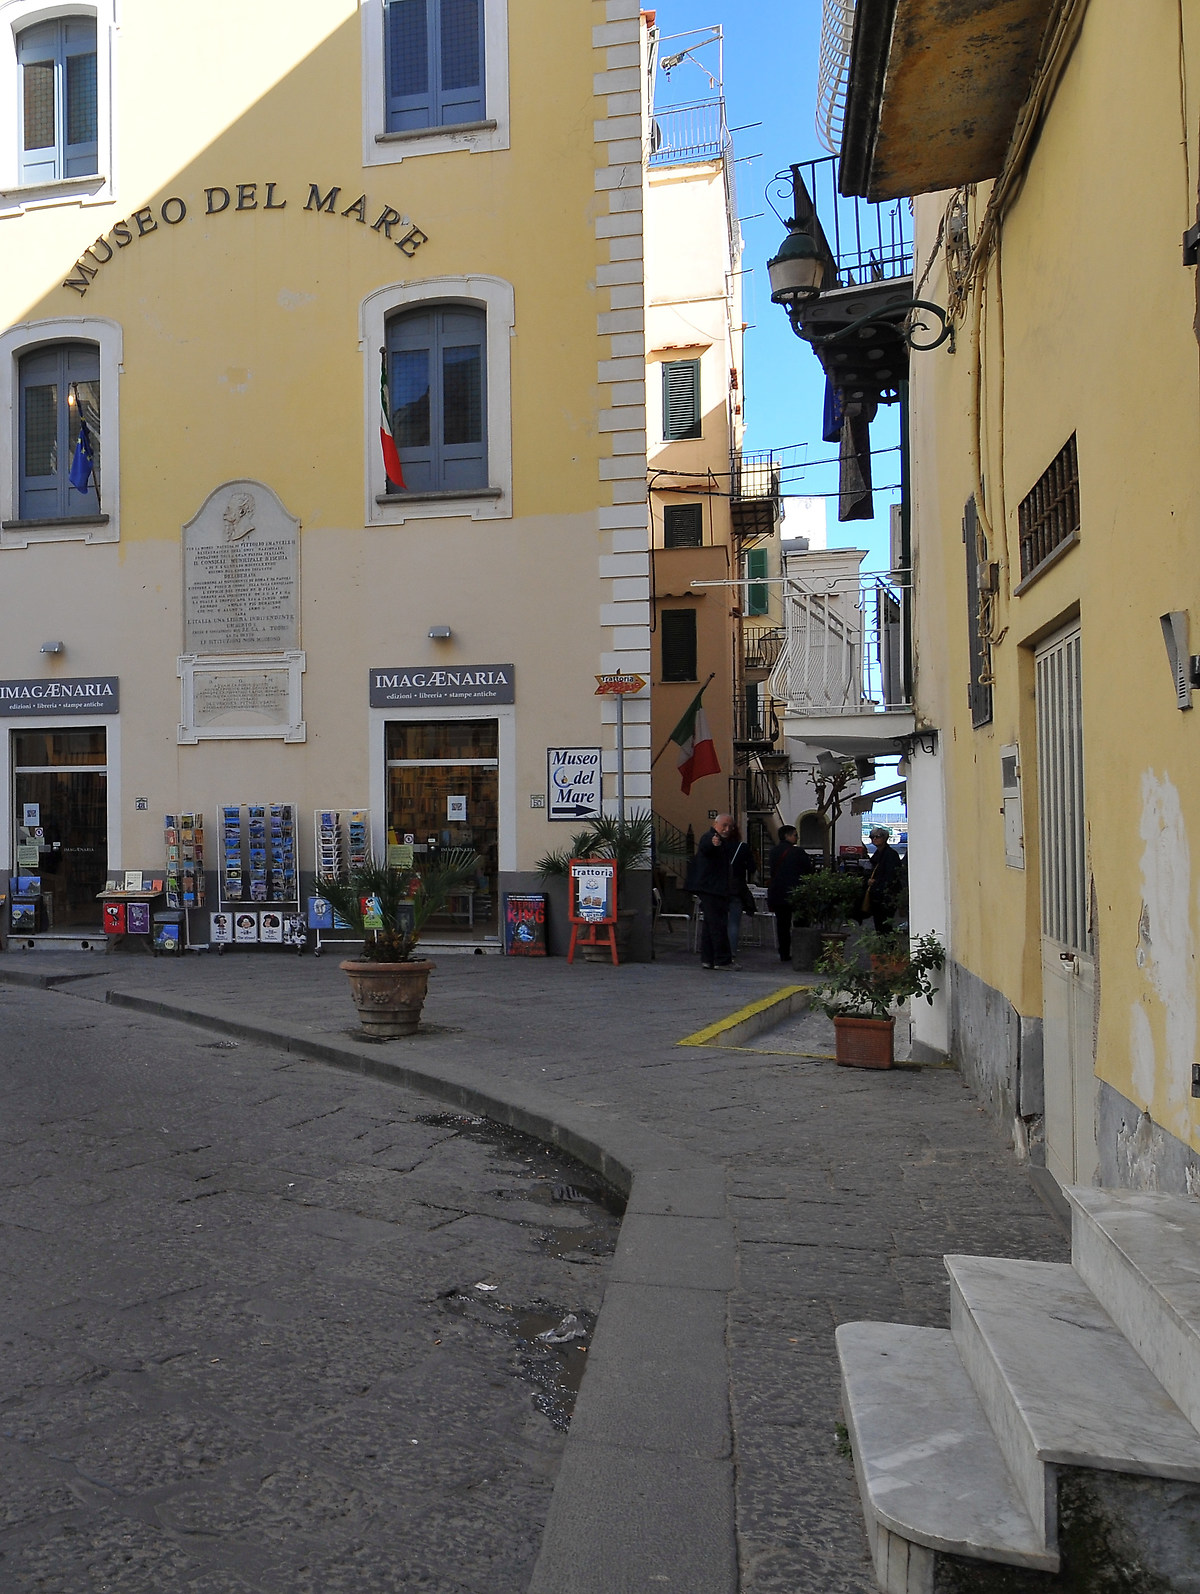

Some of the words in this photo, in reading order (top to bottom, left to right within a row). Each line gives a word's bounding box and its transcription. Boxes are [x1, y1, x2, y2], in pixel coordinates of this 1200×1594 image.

[62, 196, 187, 298] MUSEO
[203, 182, 287, 214] DEL
[302, 183, 429, 258] MARE
[376, 671, 508, 688] IMAGÆNARIA
[602, 675, 634, 683] Trattoria
[0, 683, 113, 699] IMAGÆNARIA
[386, 692, 412, 700] edizioni
[449, 692, 472, 700] stampe
[473, 690, 497, 698] antiche
[63, 702, 82, 710] stampe
[552, 751, 598, 765] Museo
[573, 771, 595, 785] del
[556, 789, 595, 803] Mare
[572, 868, 613, 877] Trattoria
[508, 901, 545, 910] STEPHEN
[507, 908, 545, 924] KING
